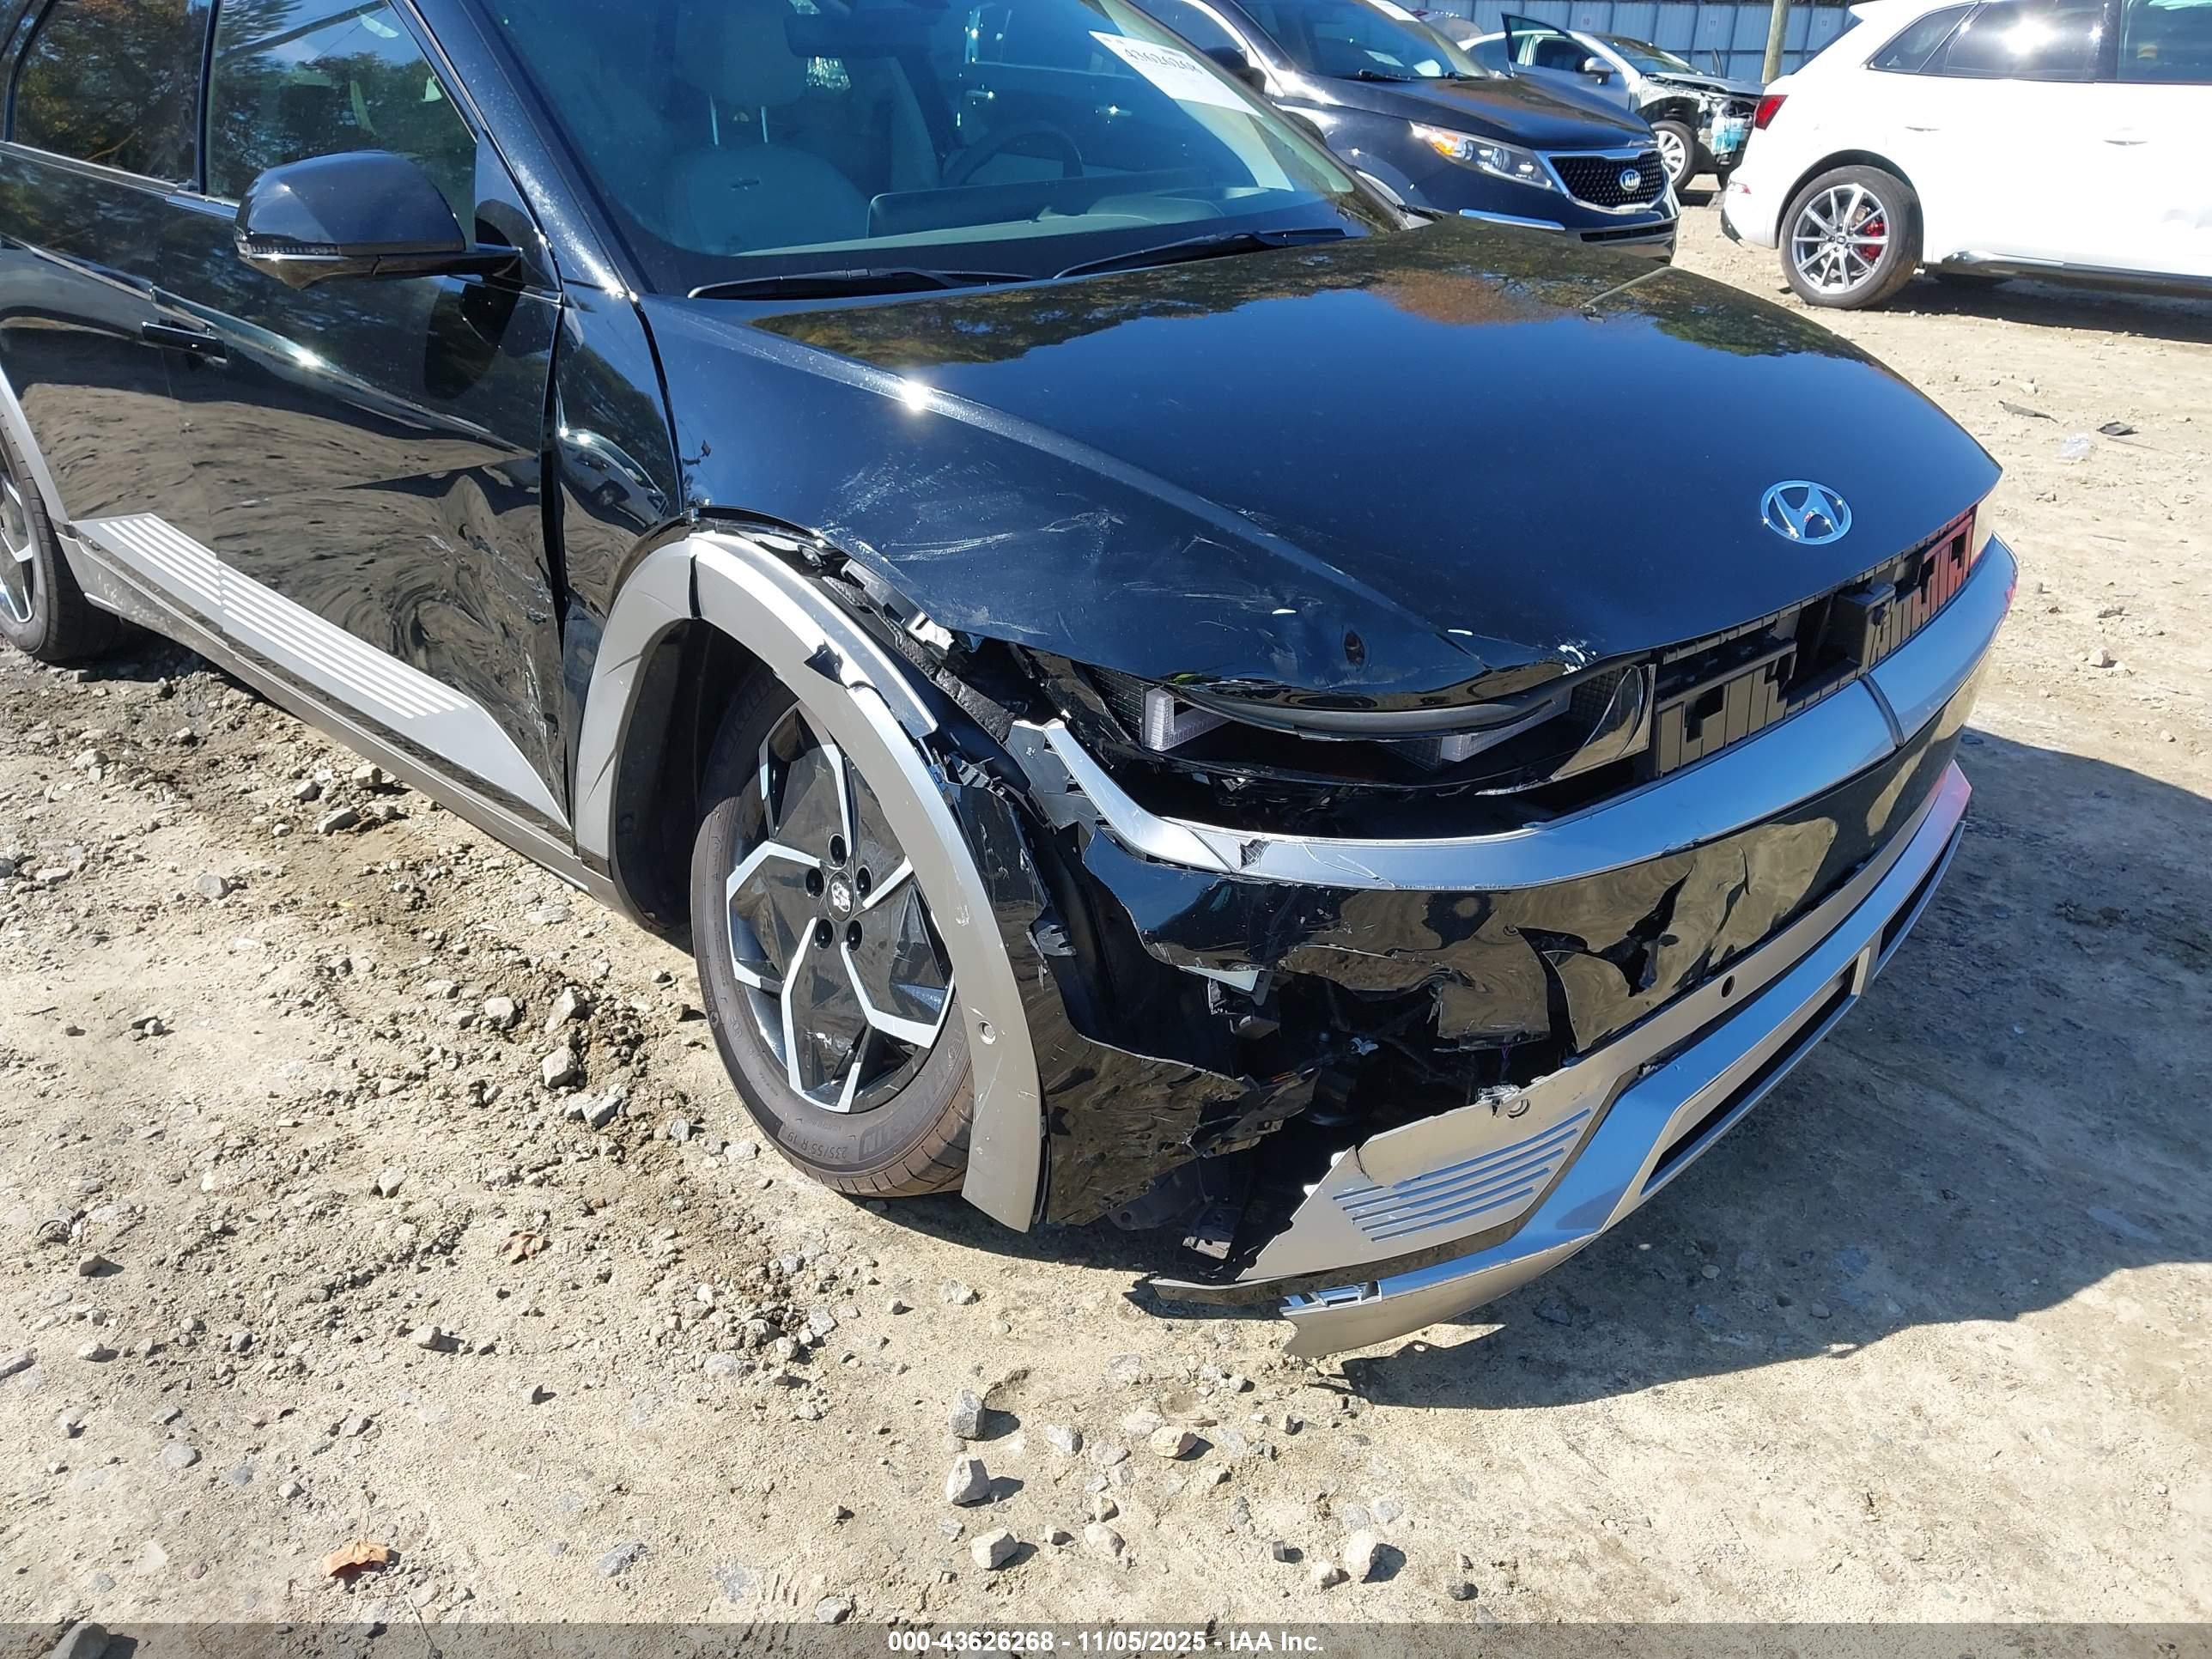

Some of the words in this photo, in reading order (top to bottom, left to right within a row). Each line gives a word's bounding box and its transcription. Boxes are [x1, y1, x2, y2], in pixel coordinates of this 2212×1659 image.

[1624, 173, 1639, 186] KIA
[787, 1131, 798, 1145] 19
[800, 1138, 808, 1151] R
[811, 1143, 848, 1160] 235/55
